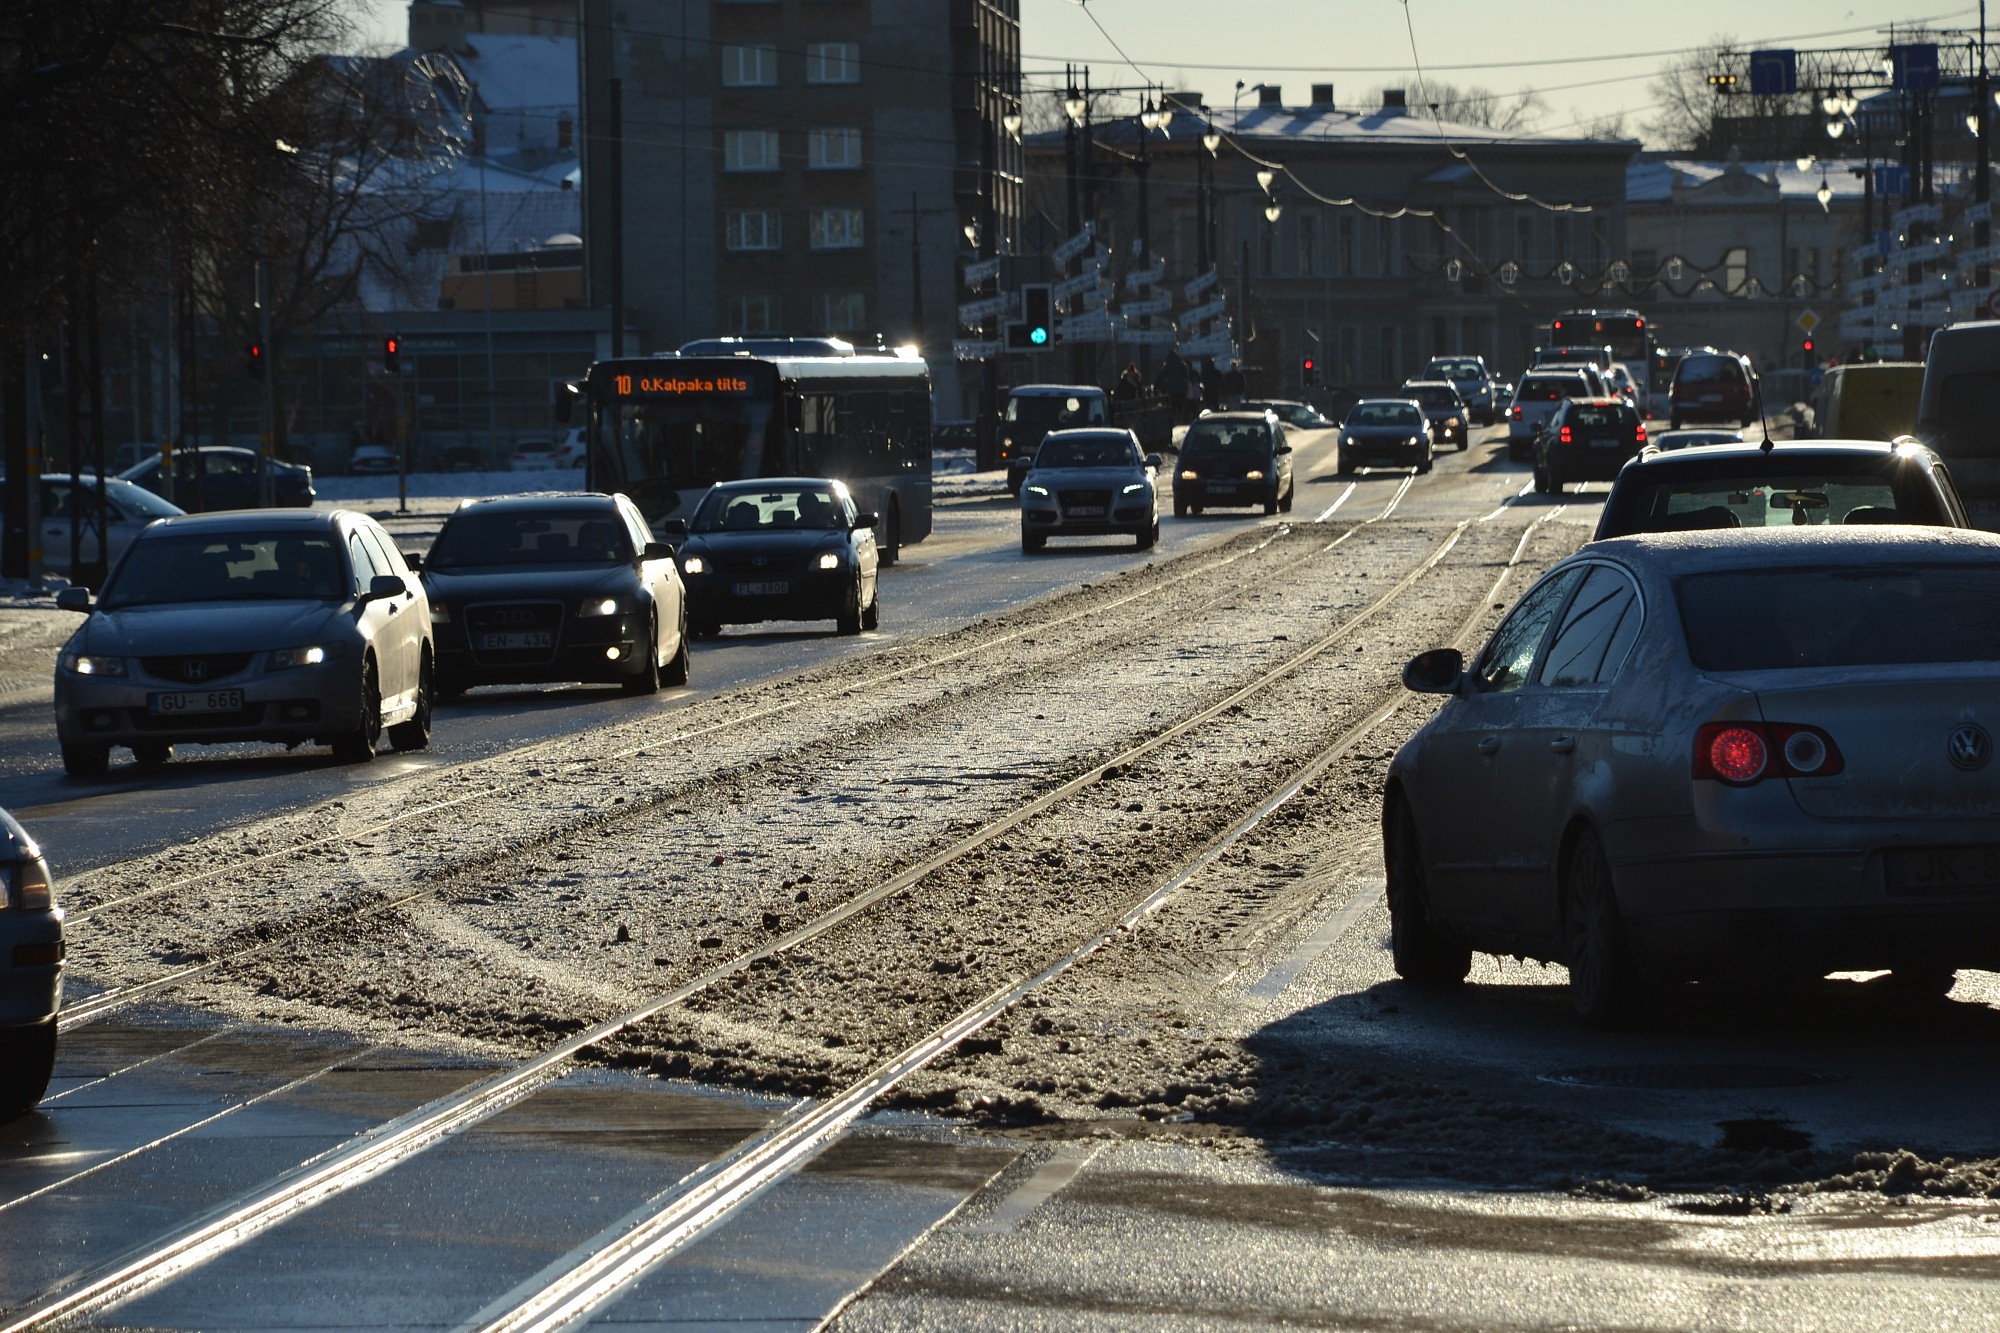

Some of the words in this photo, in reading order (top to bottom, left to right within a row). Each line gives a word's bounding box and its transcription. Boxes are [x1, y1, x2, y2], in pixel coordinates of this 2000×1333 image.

[614, 375, 632, 395] 10
[716, 377, 747, 392] tilts
[524, 633, 549, 646] 434
[207, 691, 239, 708] 666
